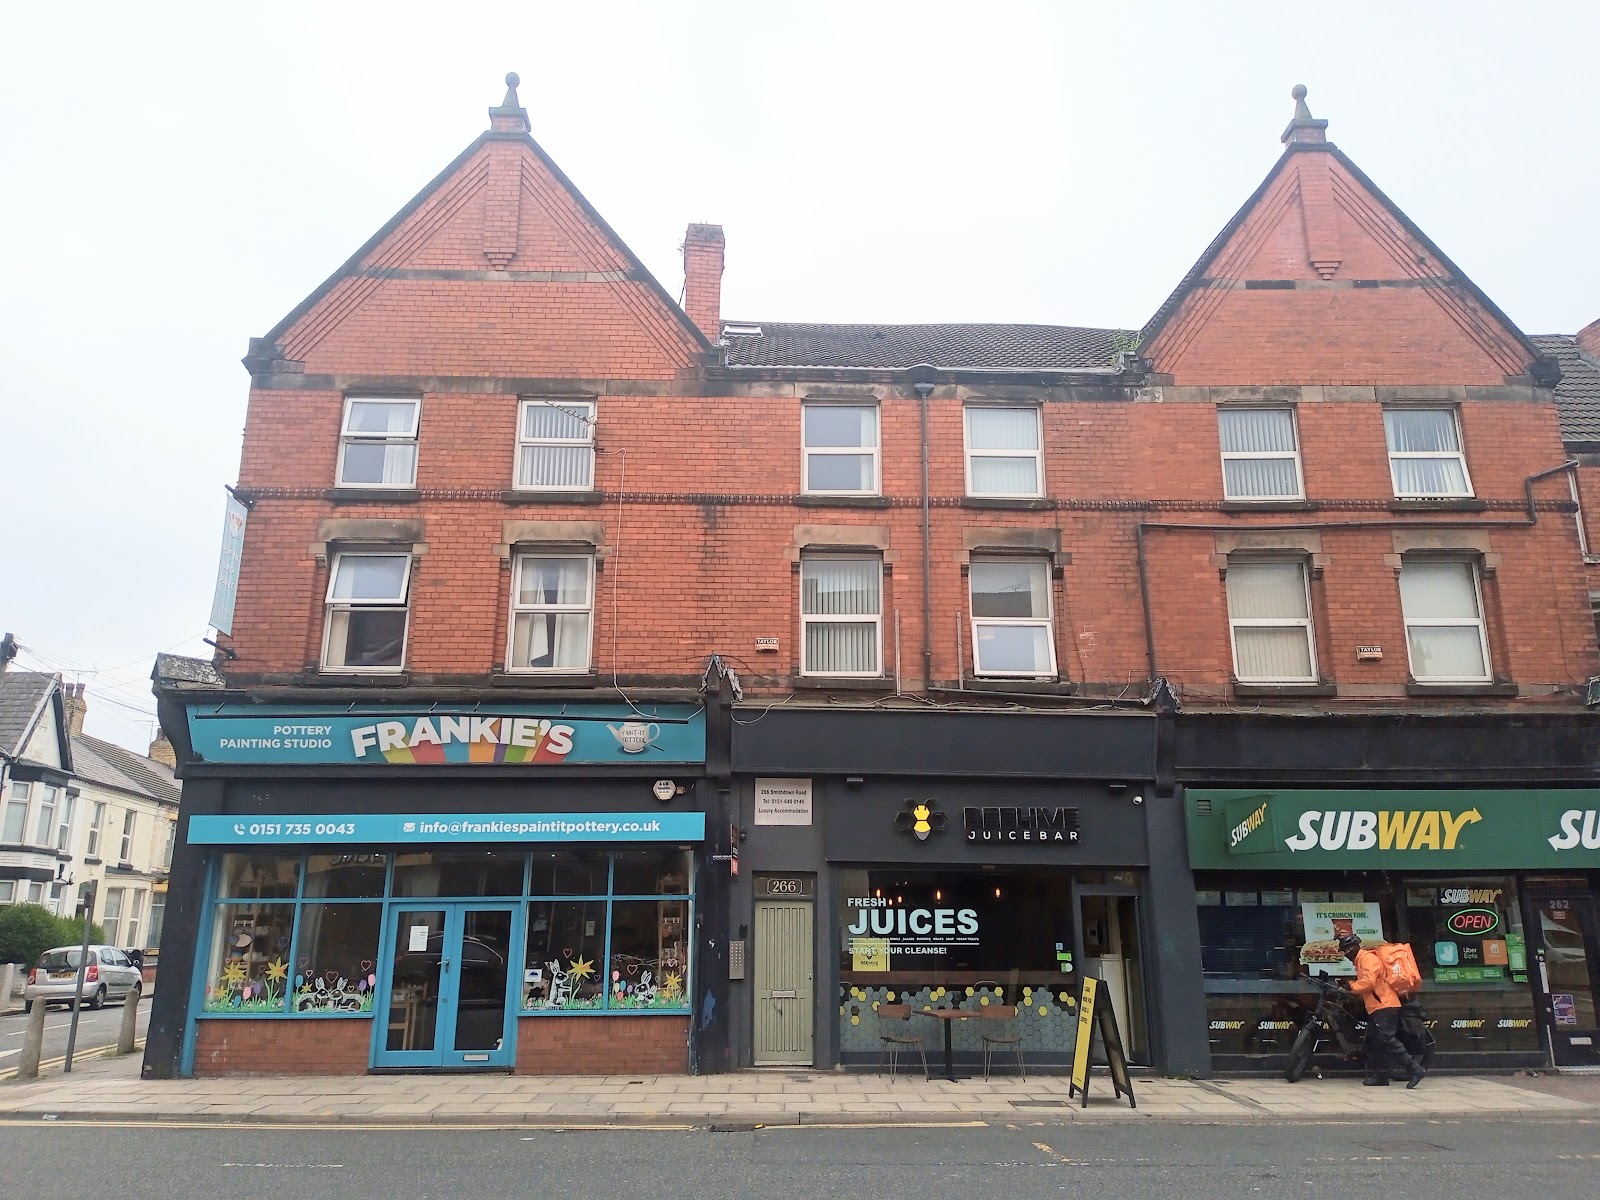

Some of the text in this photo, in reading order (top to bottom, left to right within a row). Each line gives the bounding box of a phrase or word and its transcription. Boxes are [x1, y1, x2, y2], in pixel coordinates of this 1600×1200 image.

[273, 725, 333, 736] POTTERY
[350, 715, 576, 759] FRANKIE'S
[219, 738, 332, 749] PAINTING STUDIO
[963, 806, 1080, 829] BEEHIVE
[249, 823, 356, 836] 0151 735 0043
[419, 820, 661, 835] info@frankiespaintitpottery.co.uk
[1231, 802, 1268, 847] SUBWAY
[1284, 806, 1484, 853] SUBWAY
[772, 880, 796, 893] 266
[847, 897, 887, 907] FRESH
[1440, 888, 1502, 904] SUBWAY
[1549, 900, 1569, 909] 262
[847, 908, 979, 935] JUICES
[1454, 915, 1491, 928] OPEN
[848, 947, 947, 955] START YOUR CLEANSE!
[1209, 1020, 1245, 1030] SUBWAY
[1258, 1020, 1294, 1030] SUBWAY
[1451, 1019, 1486, 1028] SUBWAY
[1497, 1019, 1532, 1028] SUBWAY
